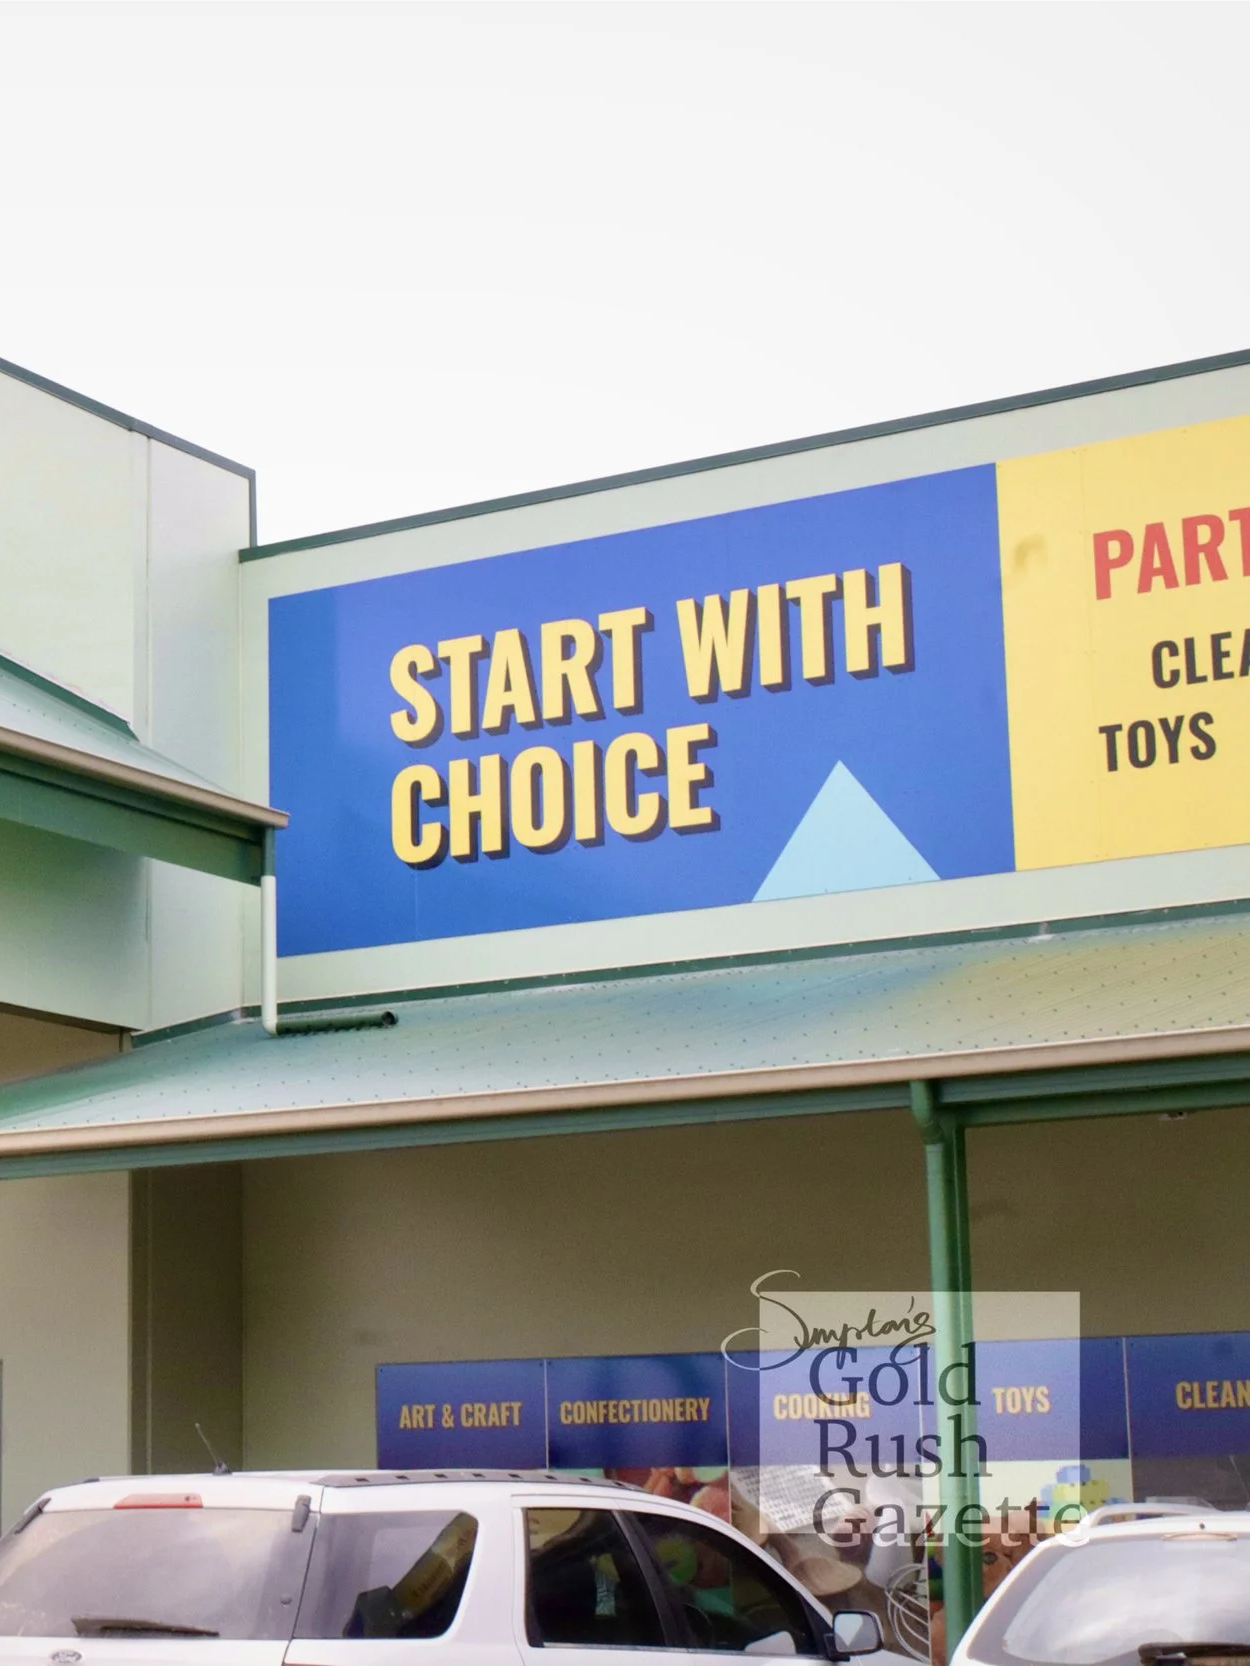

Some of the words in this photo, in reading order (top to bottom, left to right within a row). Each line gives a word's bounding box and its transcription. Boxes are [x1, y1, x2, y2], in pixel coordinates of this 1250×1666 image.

[389, 606, 654, 748] START
[677, 562, 914, 702] WITH
[1098, 711, 1217, 772] TOYS
[391, 723, 720, 868] CHOICE
[773, 1391, 871, 1421] COOKING
[992, 1386, 1051, 1415] TOYS
[1175, 1380, 1250, 1410] CLEAN
[399, 1403, 435, 1429] ART
[441, 1405, 455, 1428] &
[460, 1401, 522, 1428] CRAFT
[559, 1397, 710, 1425] CONFECTIONERY
